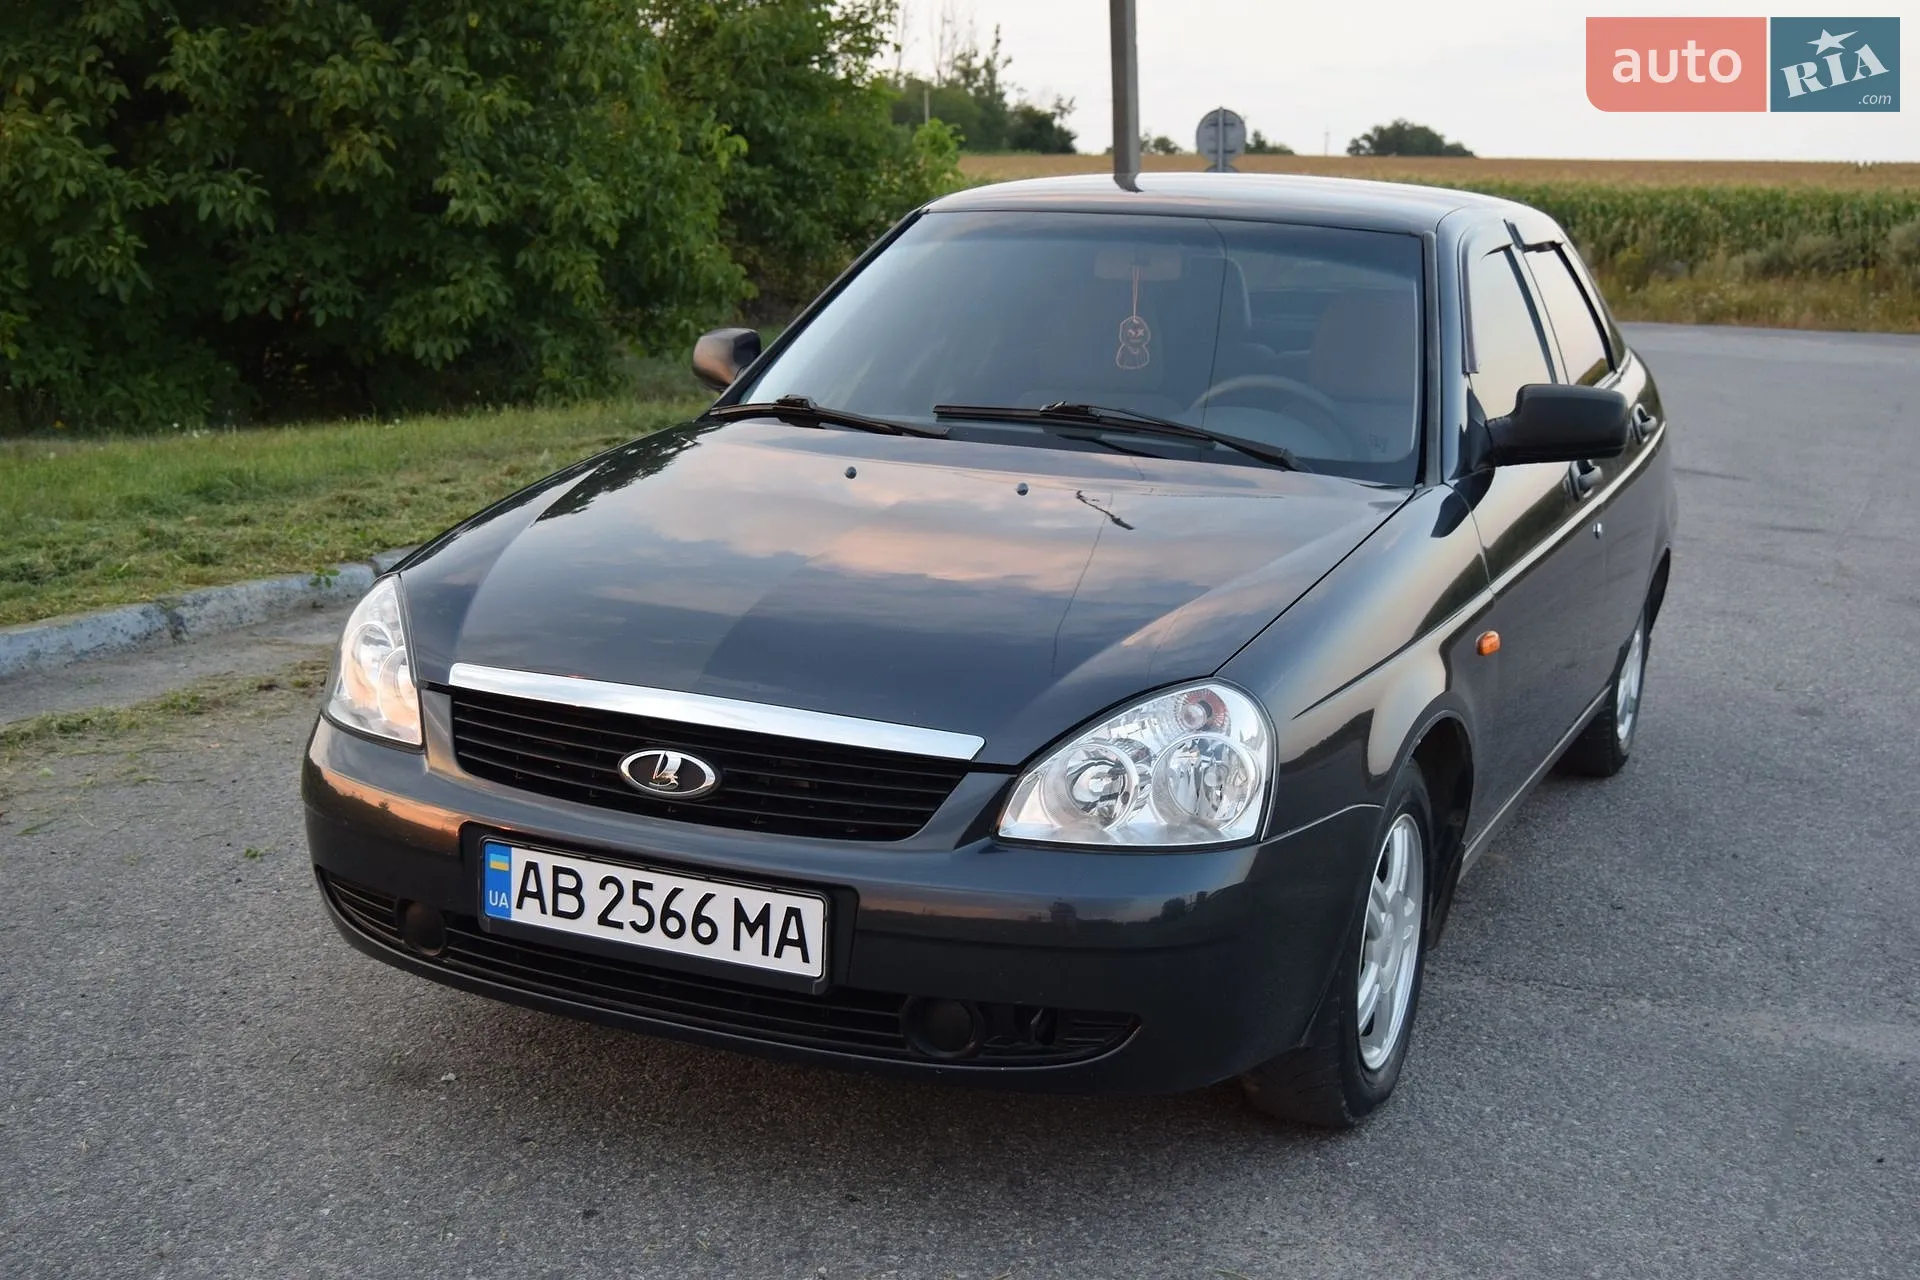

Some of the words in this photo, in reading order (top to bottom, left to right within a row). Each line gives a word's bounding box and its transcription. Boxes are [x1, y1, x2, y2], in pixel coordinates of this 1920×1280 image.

[489, 890, 509, 909] UA
[516, 861, 585, 920] AB
[598, 876, 718, 945] 2566
[733, 898, 810, 963] MA
